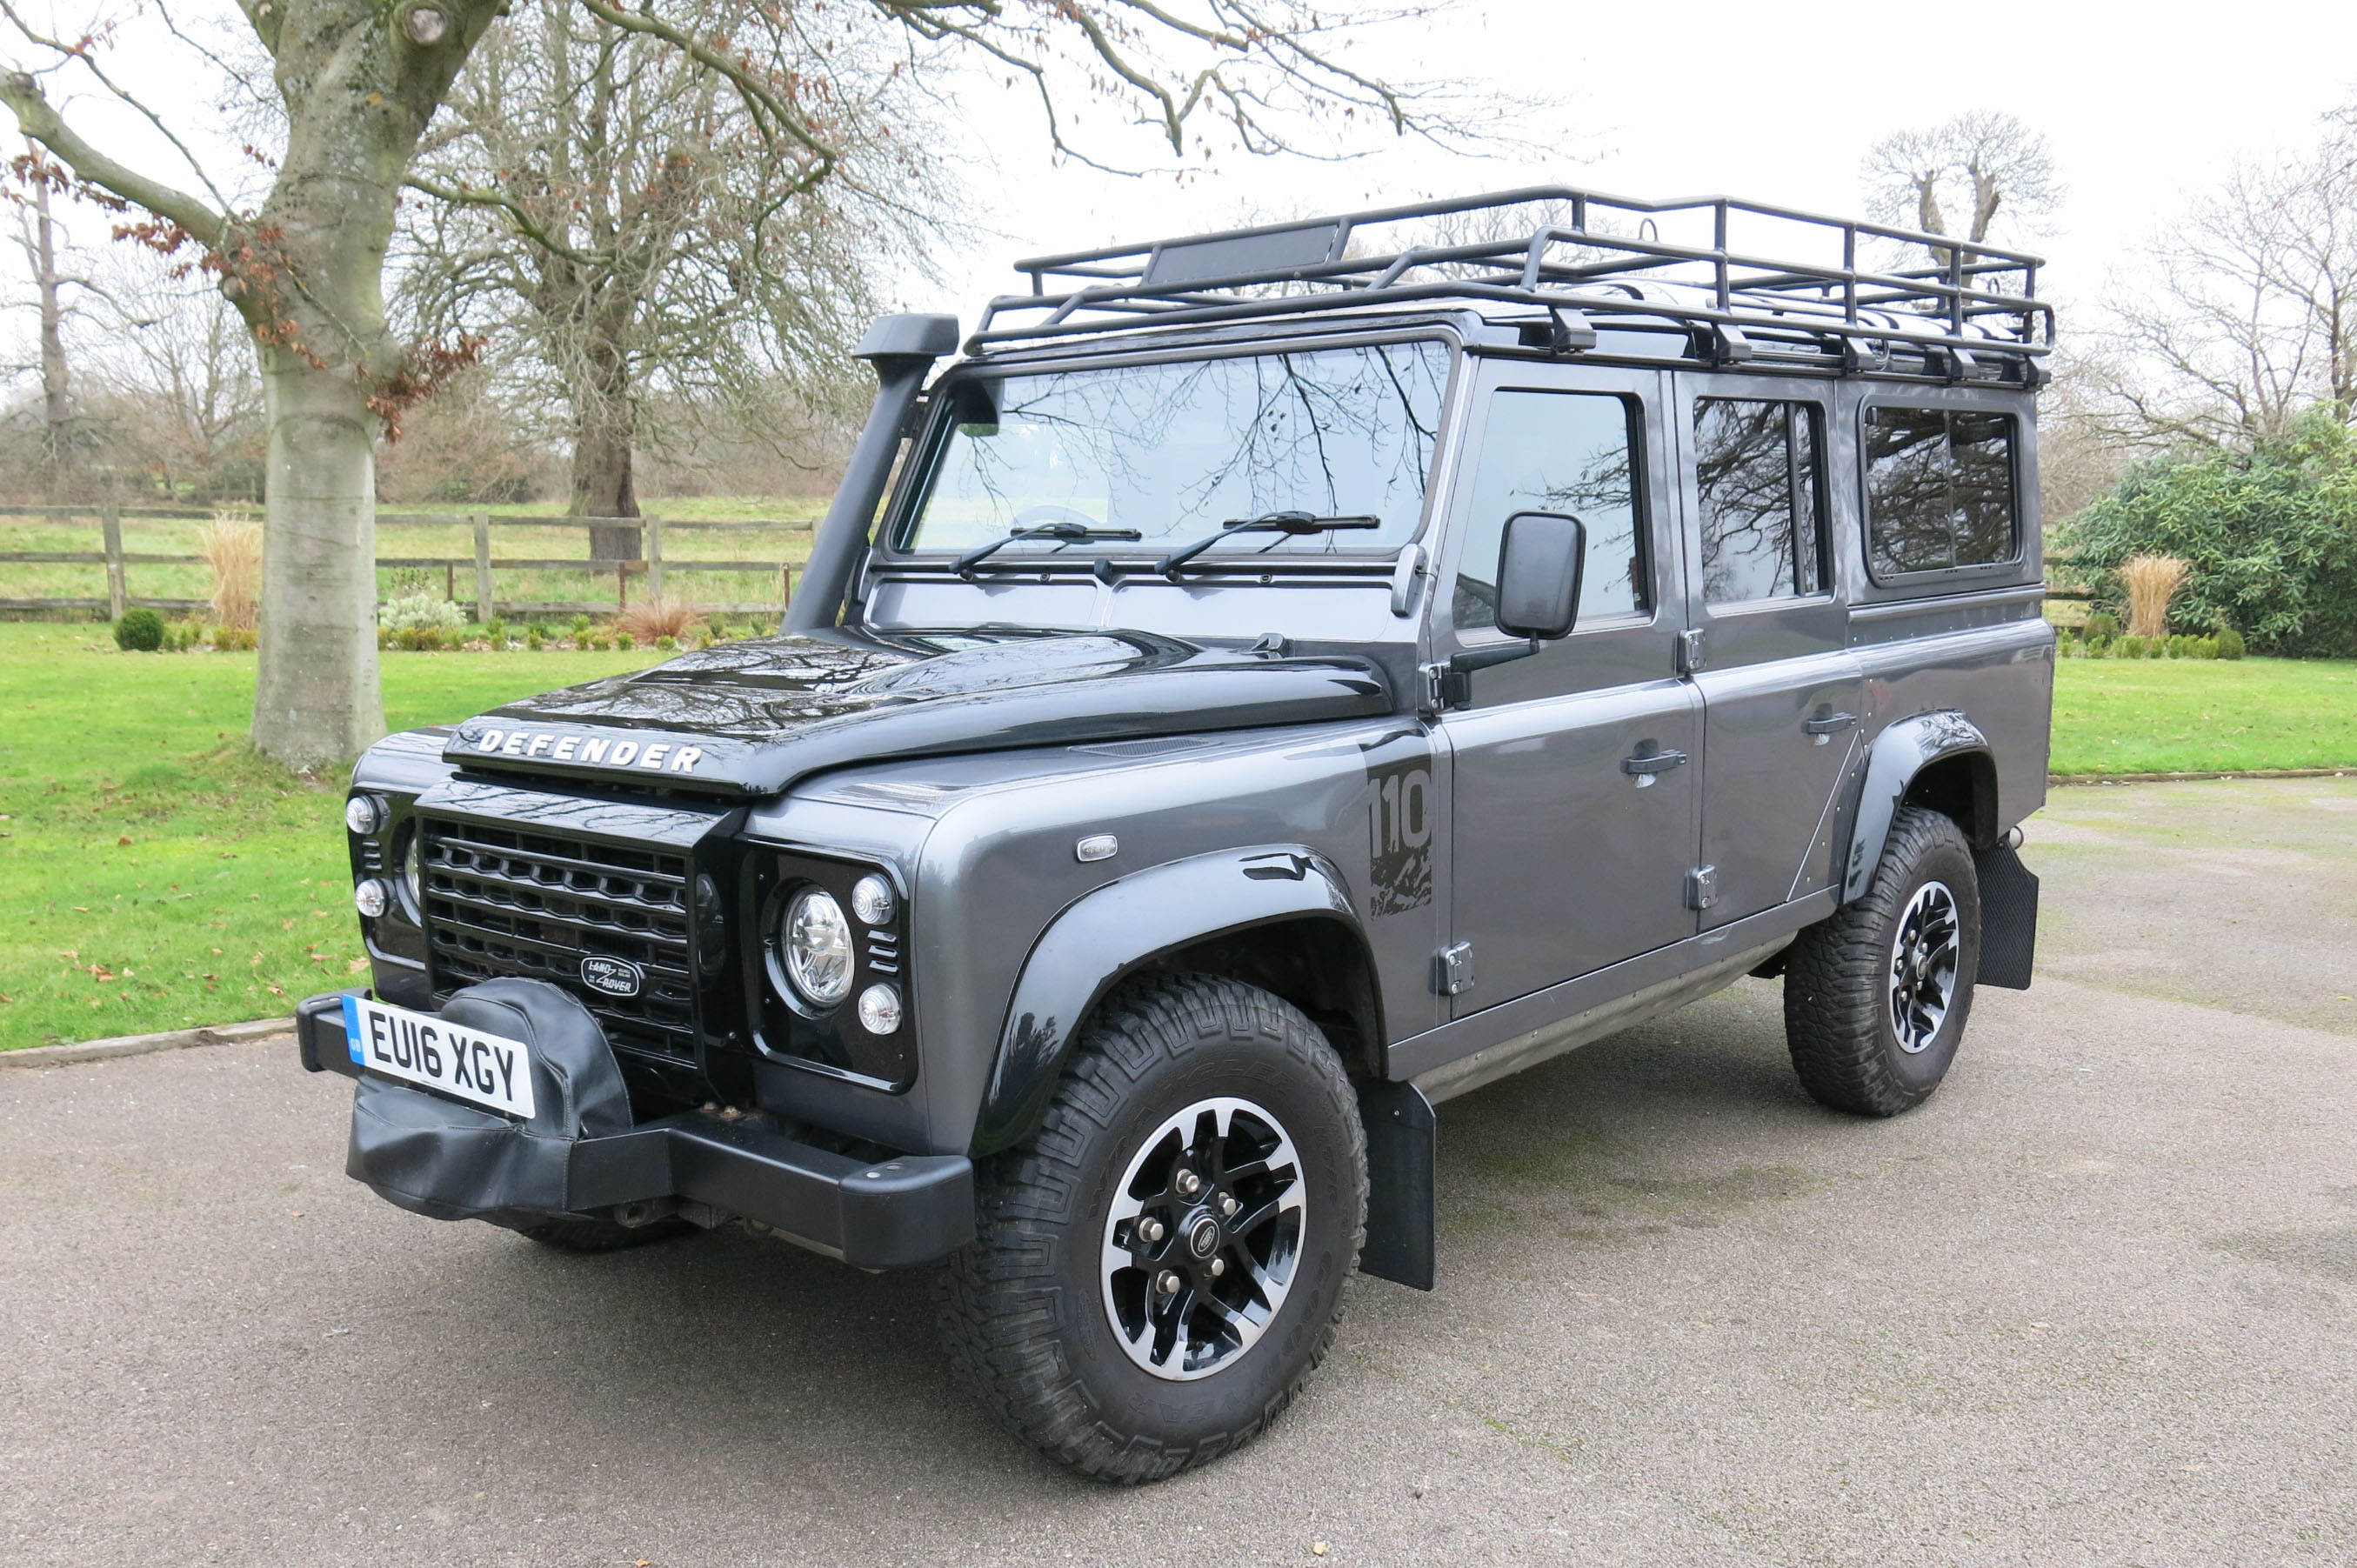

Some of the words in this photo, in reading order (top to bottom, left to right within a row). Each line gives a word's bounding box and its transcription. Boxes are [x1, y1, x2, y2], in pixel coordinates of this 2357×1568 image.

[478, 729, 703, 772] DEFENDER
[1368, 770, 1432, 858] 110
[588, 960, 611, 974] LAND
[602, 977, 631, 993] ROVER
[369, 1011, 443, 1078] EU16
[449, 1032, 513, 1102] XGY
